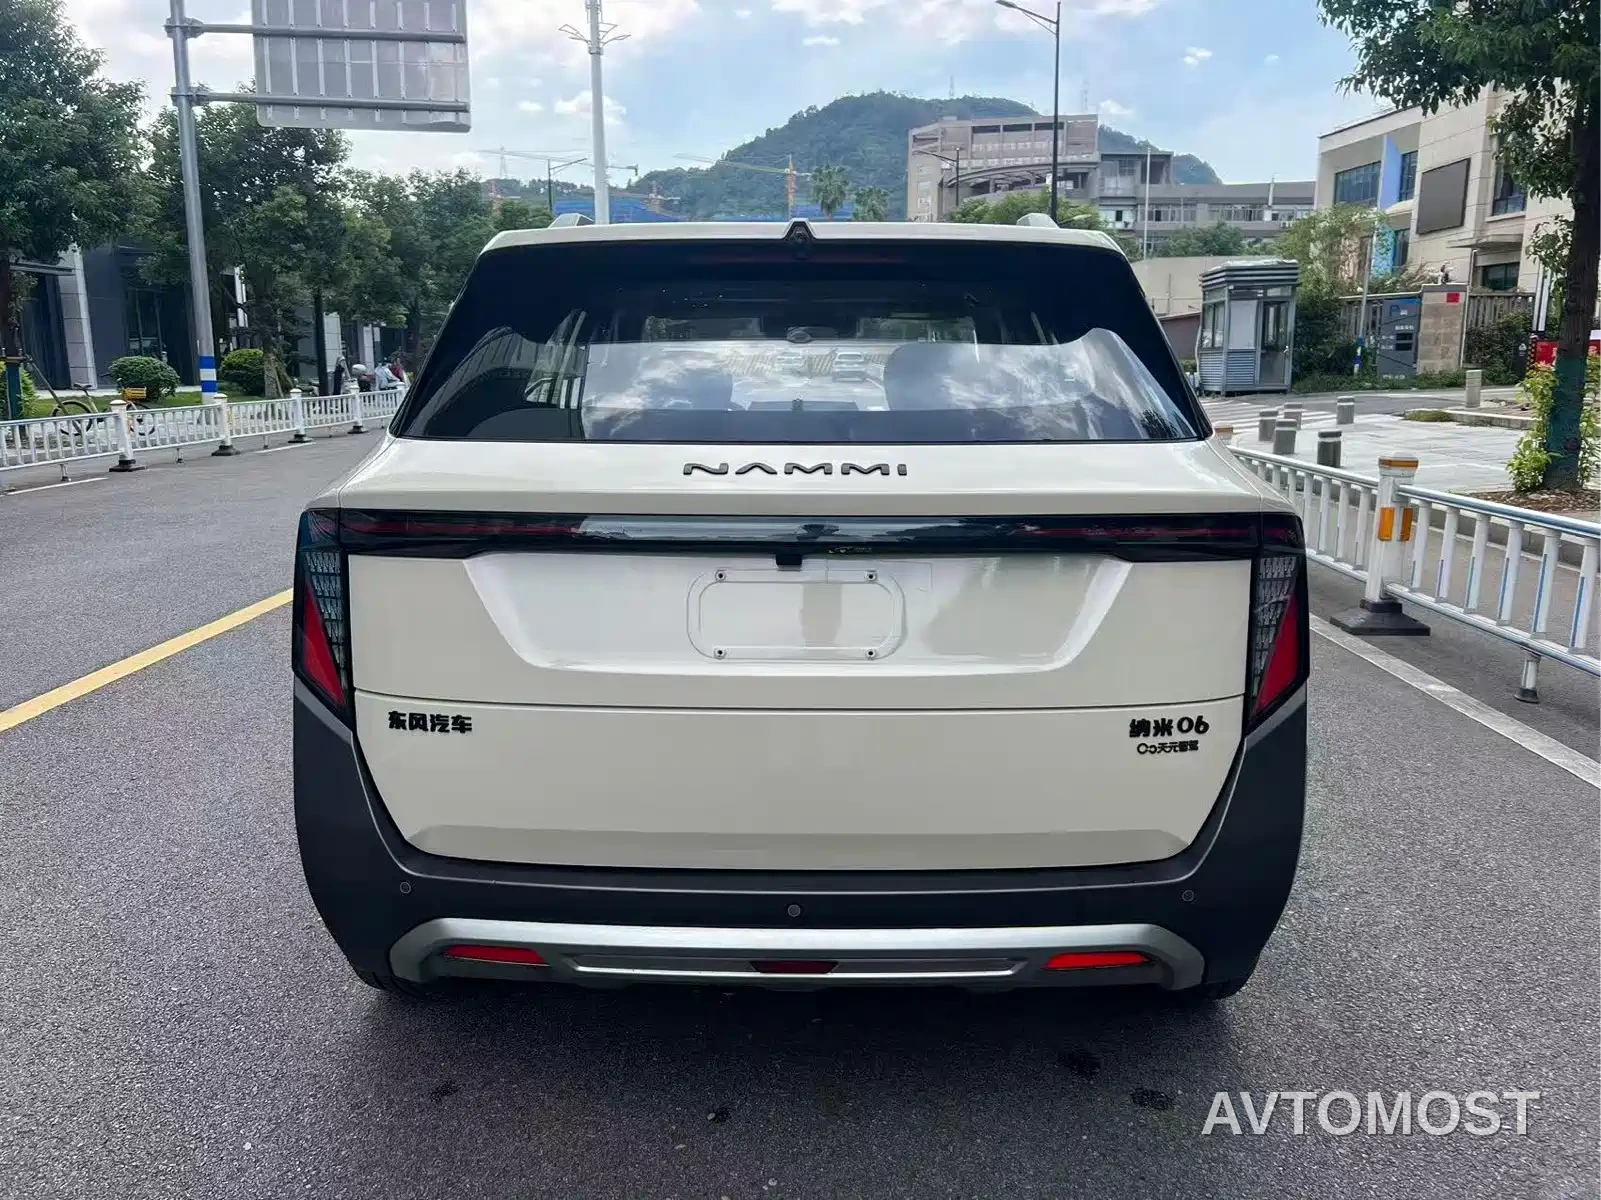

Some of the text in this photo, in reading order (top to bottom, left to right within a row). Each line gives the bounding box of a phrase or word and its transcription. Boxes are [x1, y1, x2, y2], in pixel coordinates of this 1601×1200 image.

[683, 462, 907, 475] NAMMI
[388, 710, 472, 733] 东风汽车
